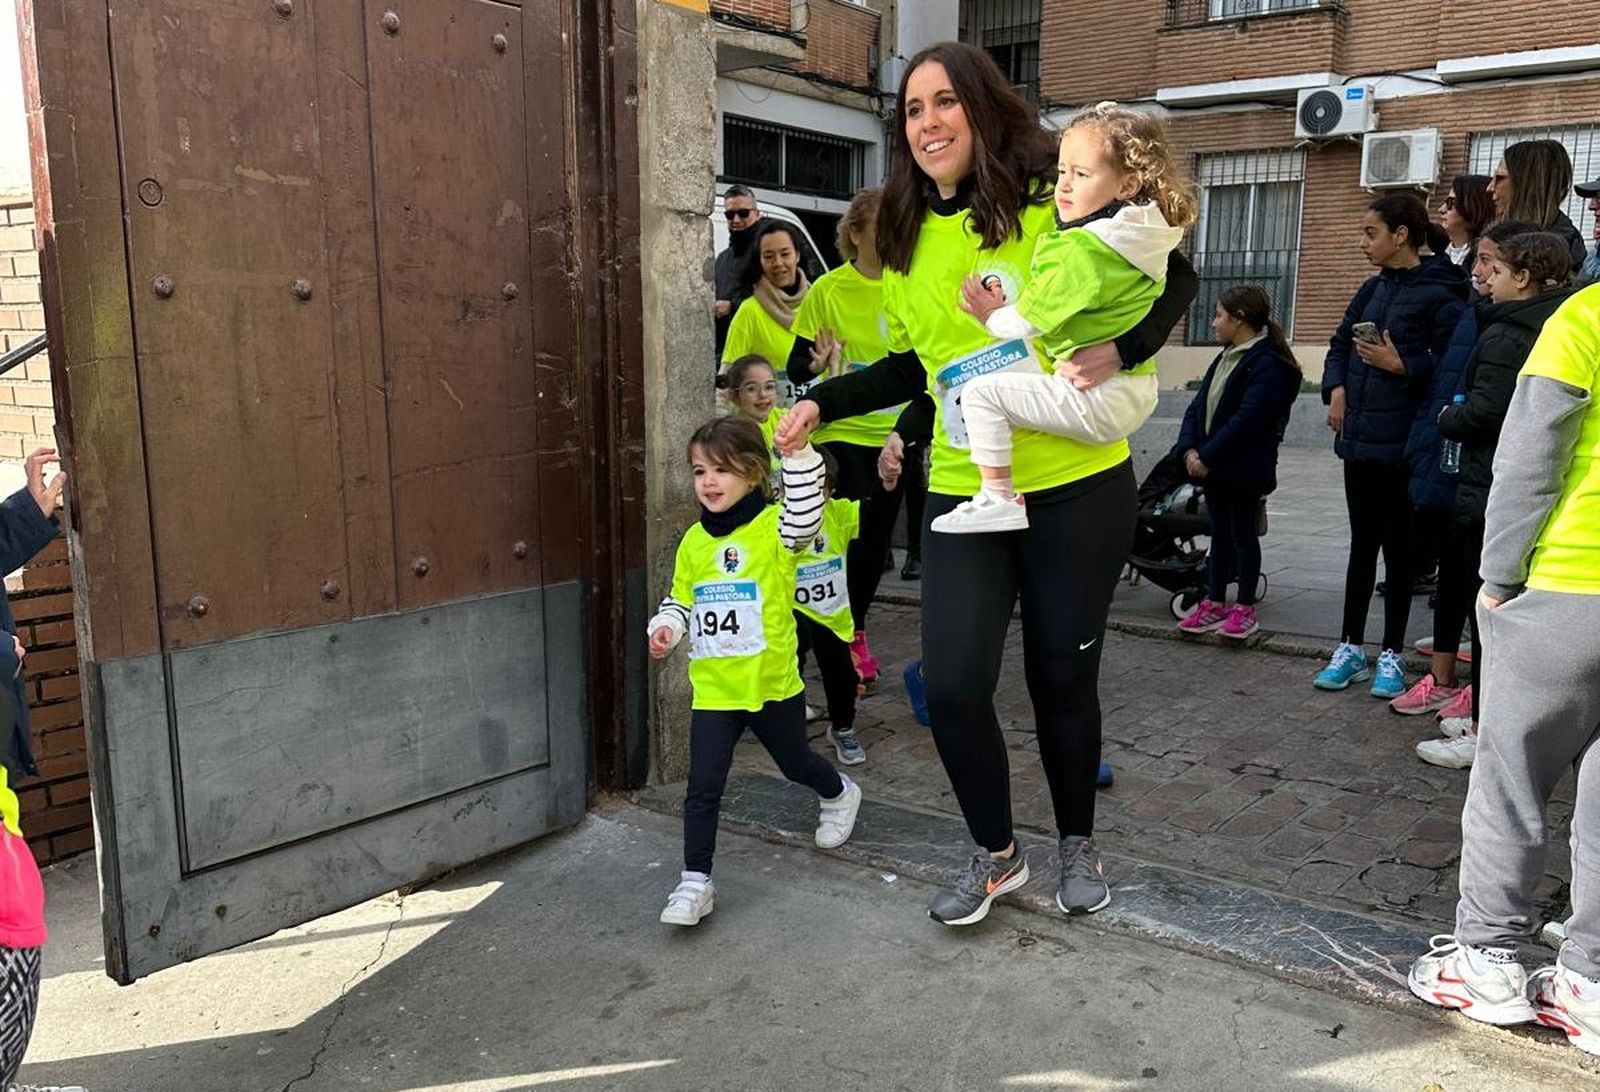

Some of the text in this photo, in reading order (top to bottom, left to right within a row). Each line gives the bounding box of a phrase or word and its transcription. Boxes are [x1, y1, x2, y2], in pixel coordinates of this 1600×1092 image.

[960, 349, 1001, 372] COLEGIO
[978, 350, 1022, 377] PASTORA
[795, 580, 837, 604] 031
[695, 609, 740, 637] 194
